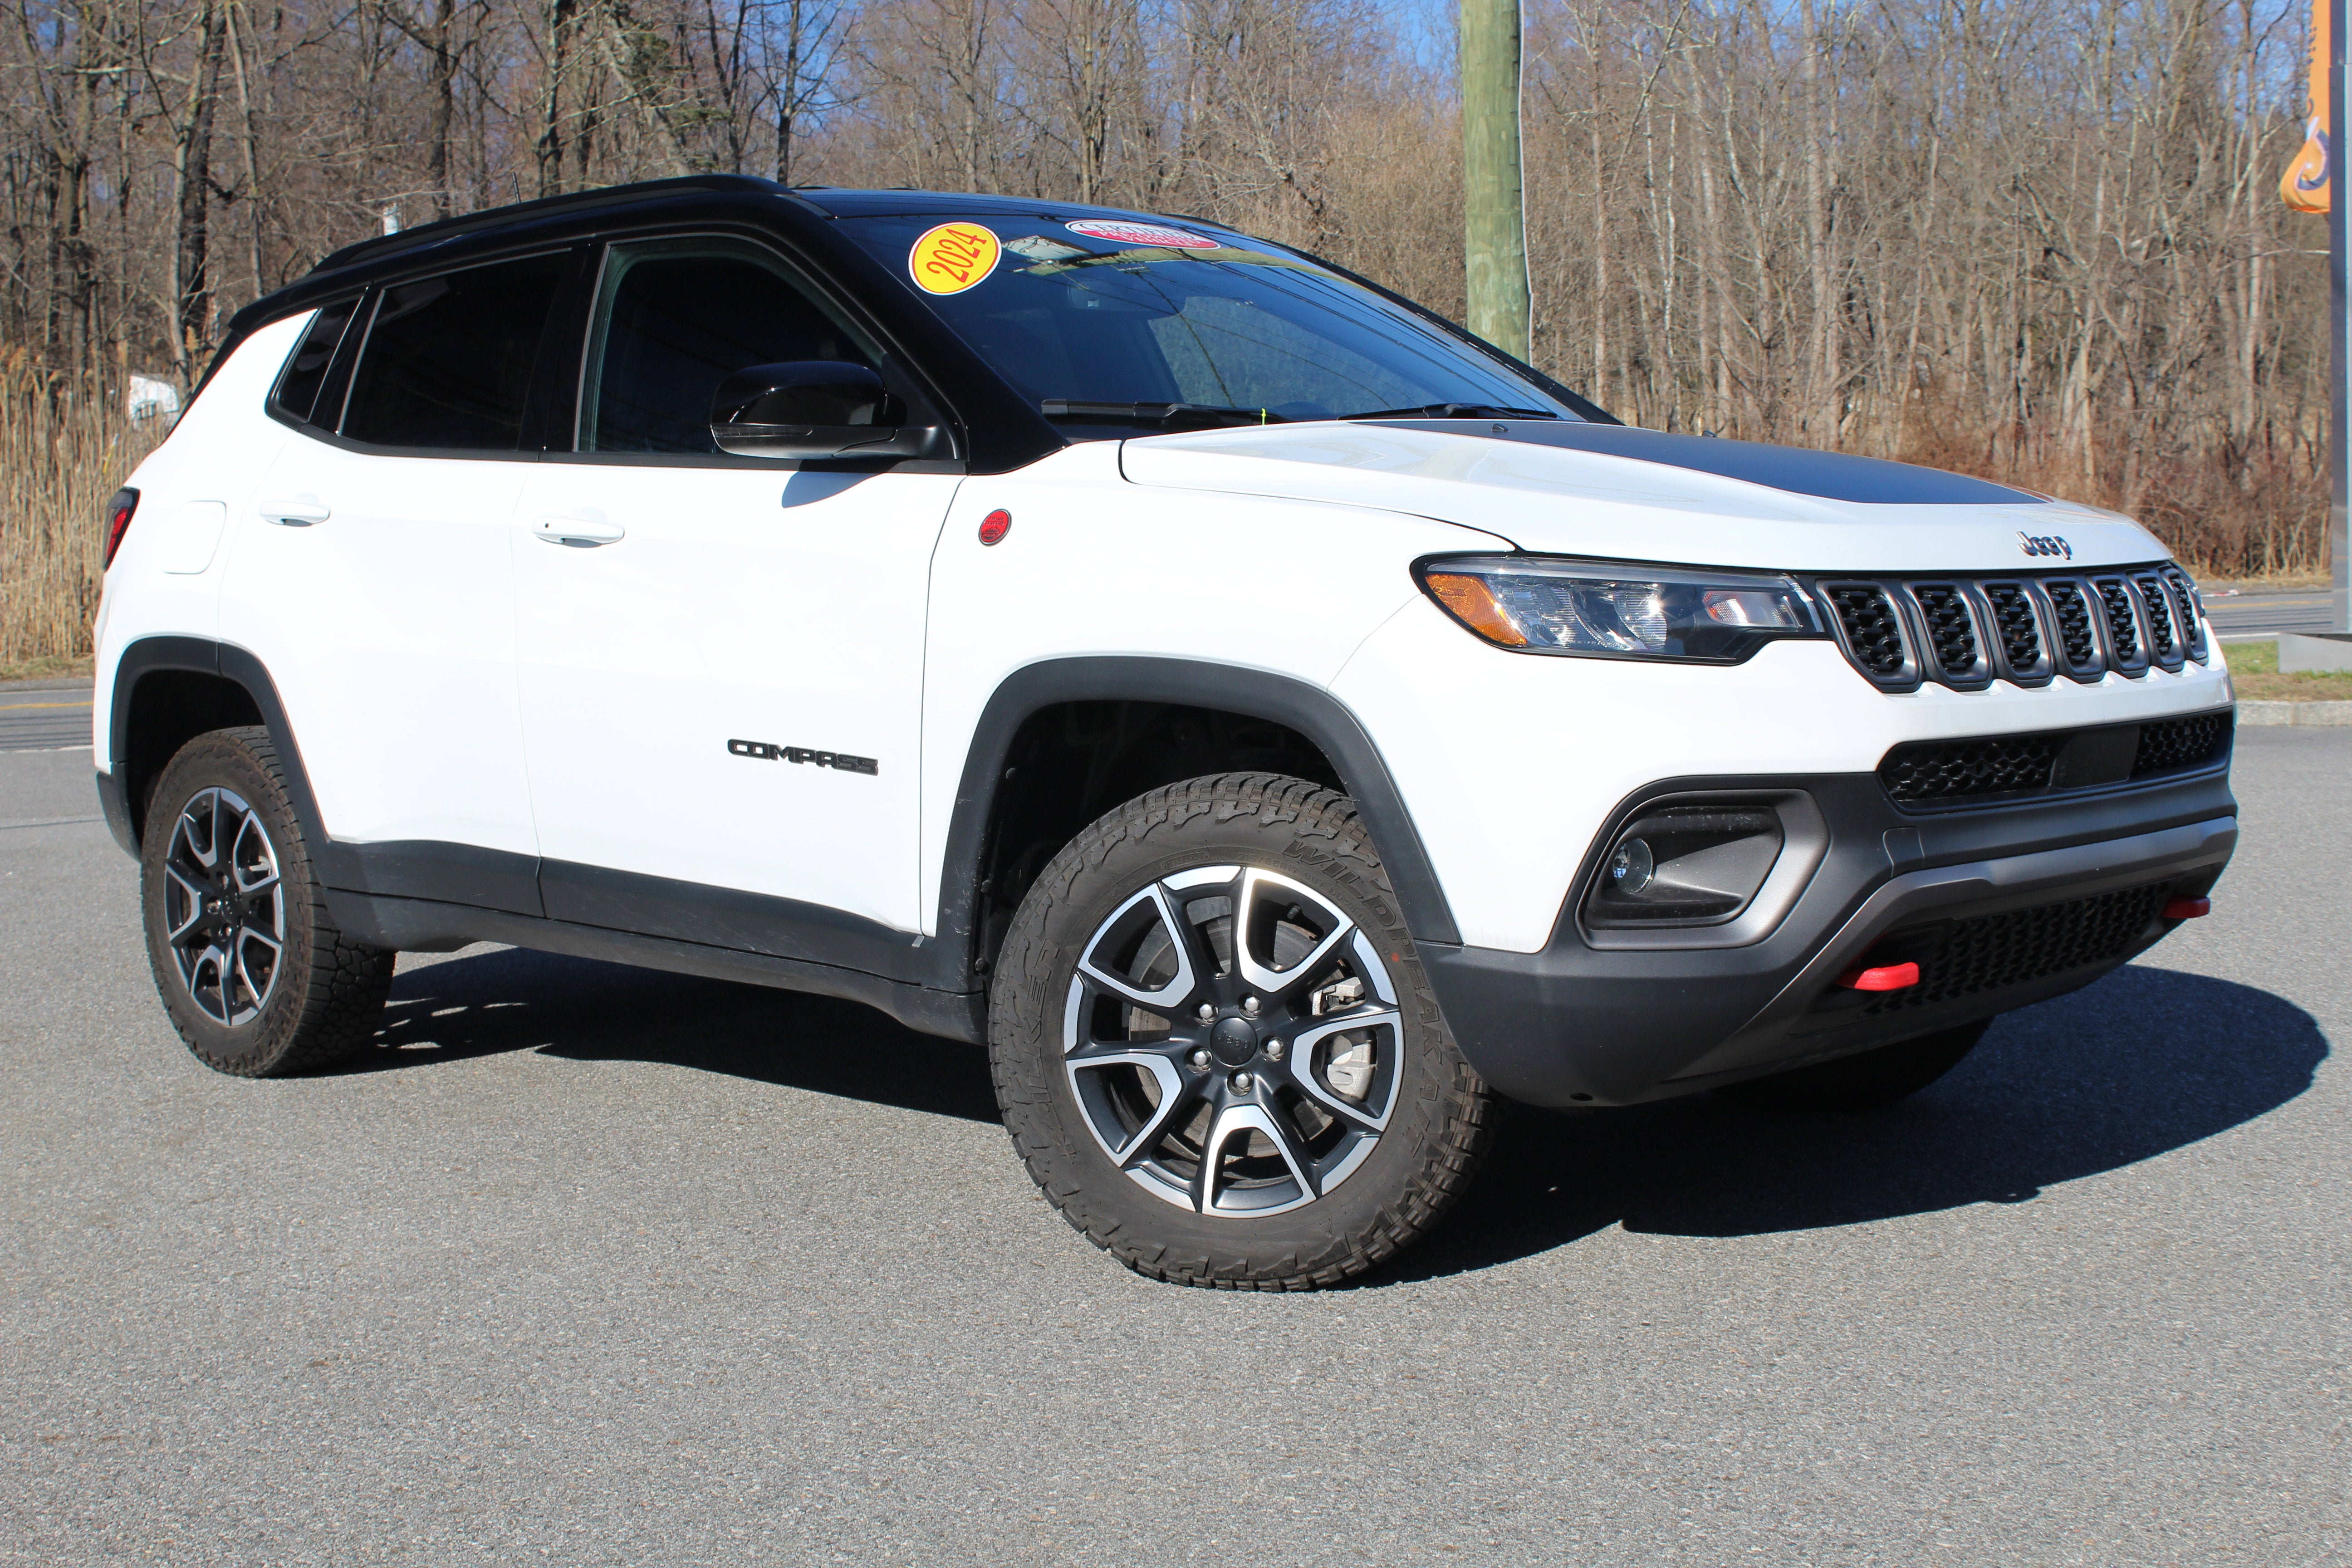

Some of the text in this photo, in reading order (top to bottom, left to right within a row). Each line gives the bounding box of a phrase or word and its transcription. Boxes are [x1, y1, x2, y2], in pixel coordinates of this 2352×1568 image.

[1079, 224, 1196, 239] CERTIFIED
[1097, 231, 1201, 244] PRE-OWNED
[1121, 236, 1197, 246] VEHICLE
[926, 229, 987, 283] 2024
[2016, 531, 2072, 560] Jeep
[727, 739, 879, 776] COMPASS
[1282, 839, 1442, 1065] WILDPEAK
[1216, 1029, 1251, 1052] Jeep
